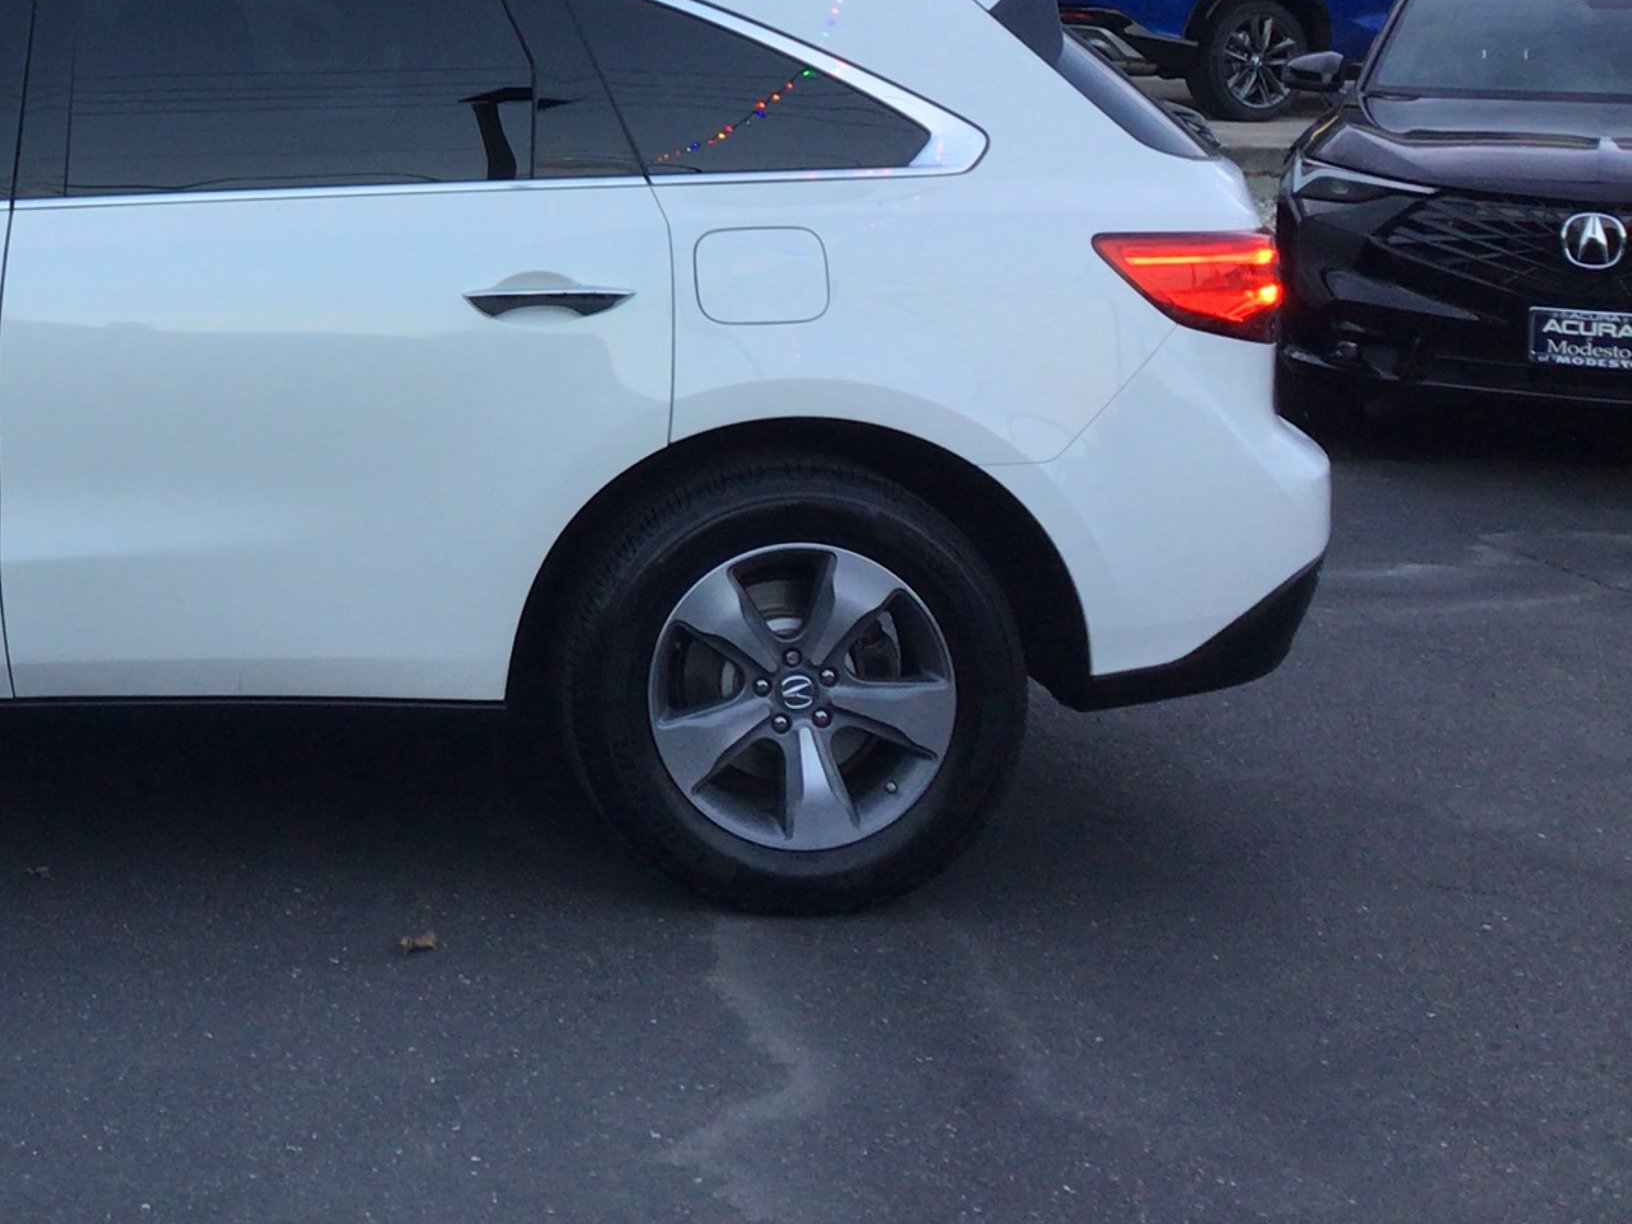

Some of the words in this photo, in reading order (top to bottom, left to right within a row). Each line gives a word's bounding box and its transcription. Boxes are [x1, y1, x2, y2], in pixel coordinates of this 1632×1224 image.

[1542, 318, 1632, 338] ACURA
[1546, 338, 1632, 359] Modesto
[1555, 355, 1632, 369] MODEST
